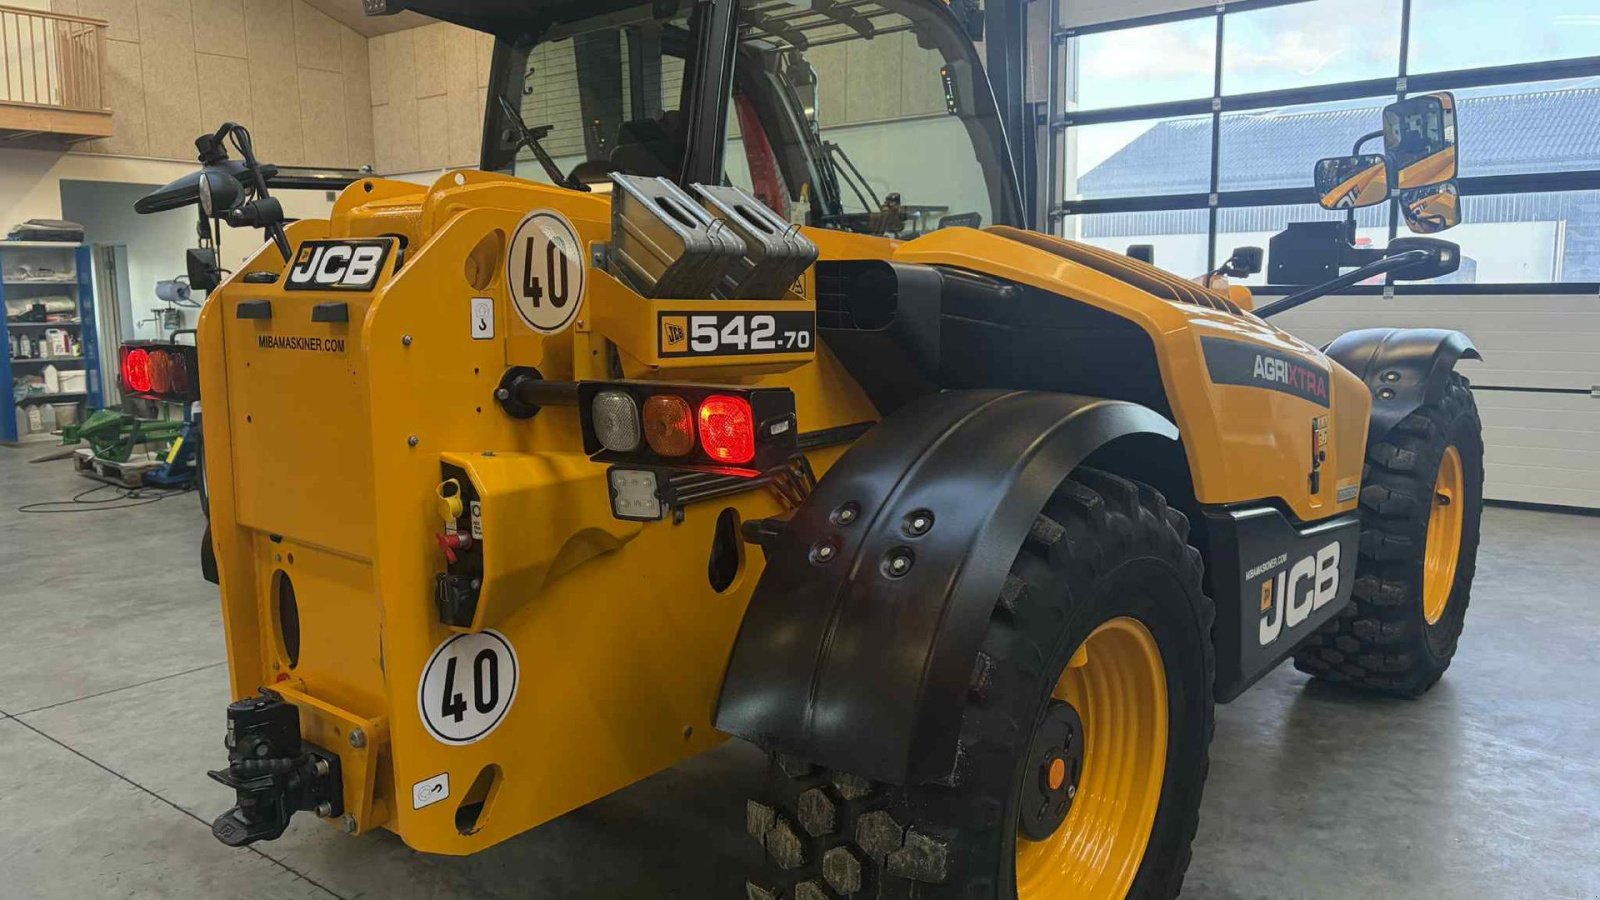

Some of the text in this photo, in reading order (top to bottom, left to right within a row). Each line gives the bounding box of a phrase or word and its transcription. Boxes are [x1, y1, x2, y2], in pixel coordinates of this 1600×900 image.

[291, 245, 383, 284] JCB
[523, 236, 568, 308] 40
[258, 335, 345, 353] MIBAMASKINER.COM
[1253, 354, 1327, 399] AGRIXTRA
[1259, 540, 1340, 645] JCB
[442, 649, 499, 723] 40
